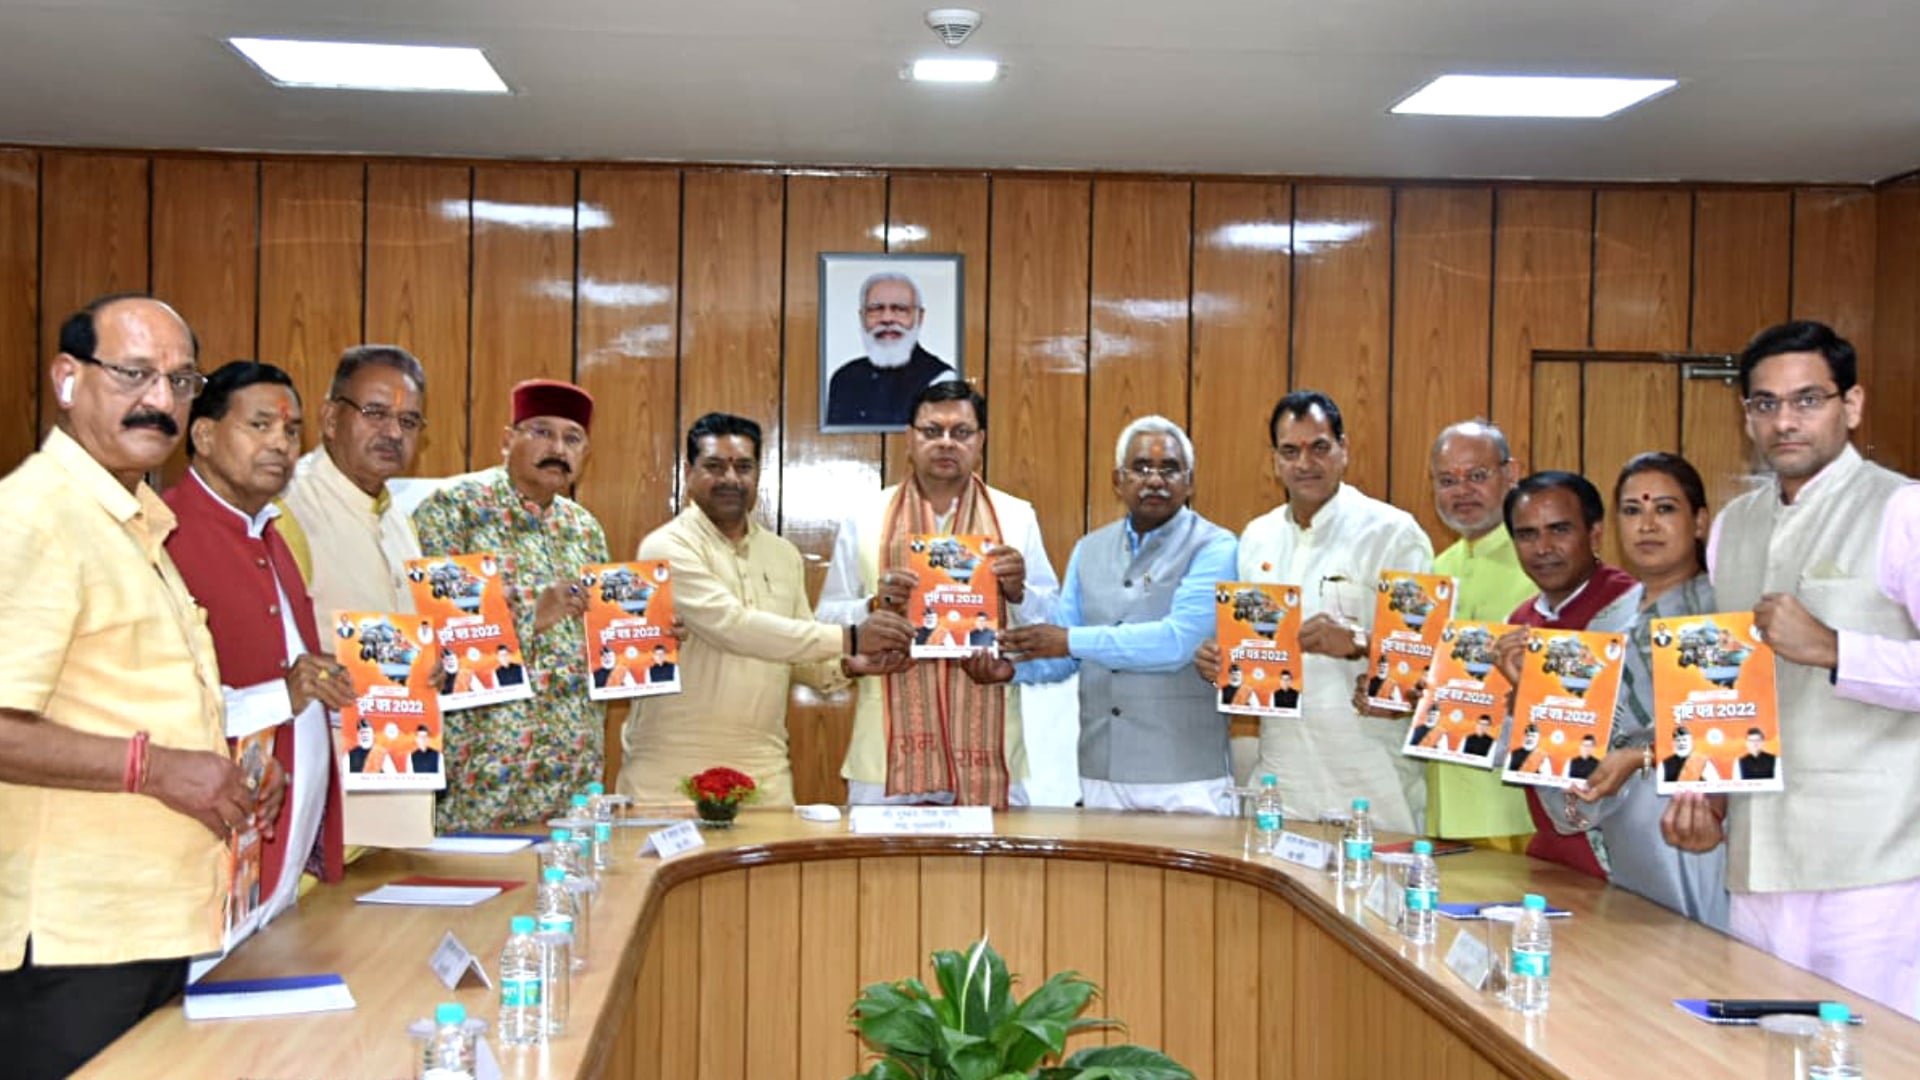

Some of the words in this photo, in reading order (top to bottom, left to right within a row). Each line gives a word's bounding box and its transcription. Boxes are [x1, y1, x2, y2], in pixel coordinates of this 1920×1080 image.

[955, 593, 984, 604] 2022
[471, 624, 501, 638] 2022
[632, 626, 661, 639] 2022
[392, 700, 425, 714] 2022
[1716, 701, 1756, 718] 2022
